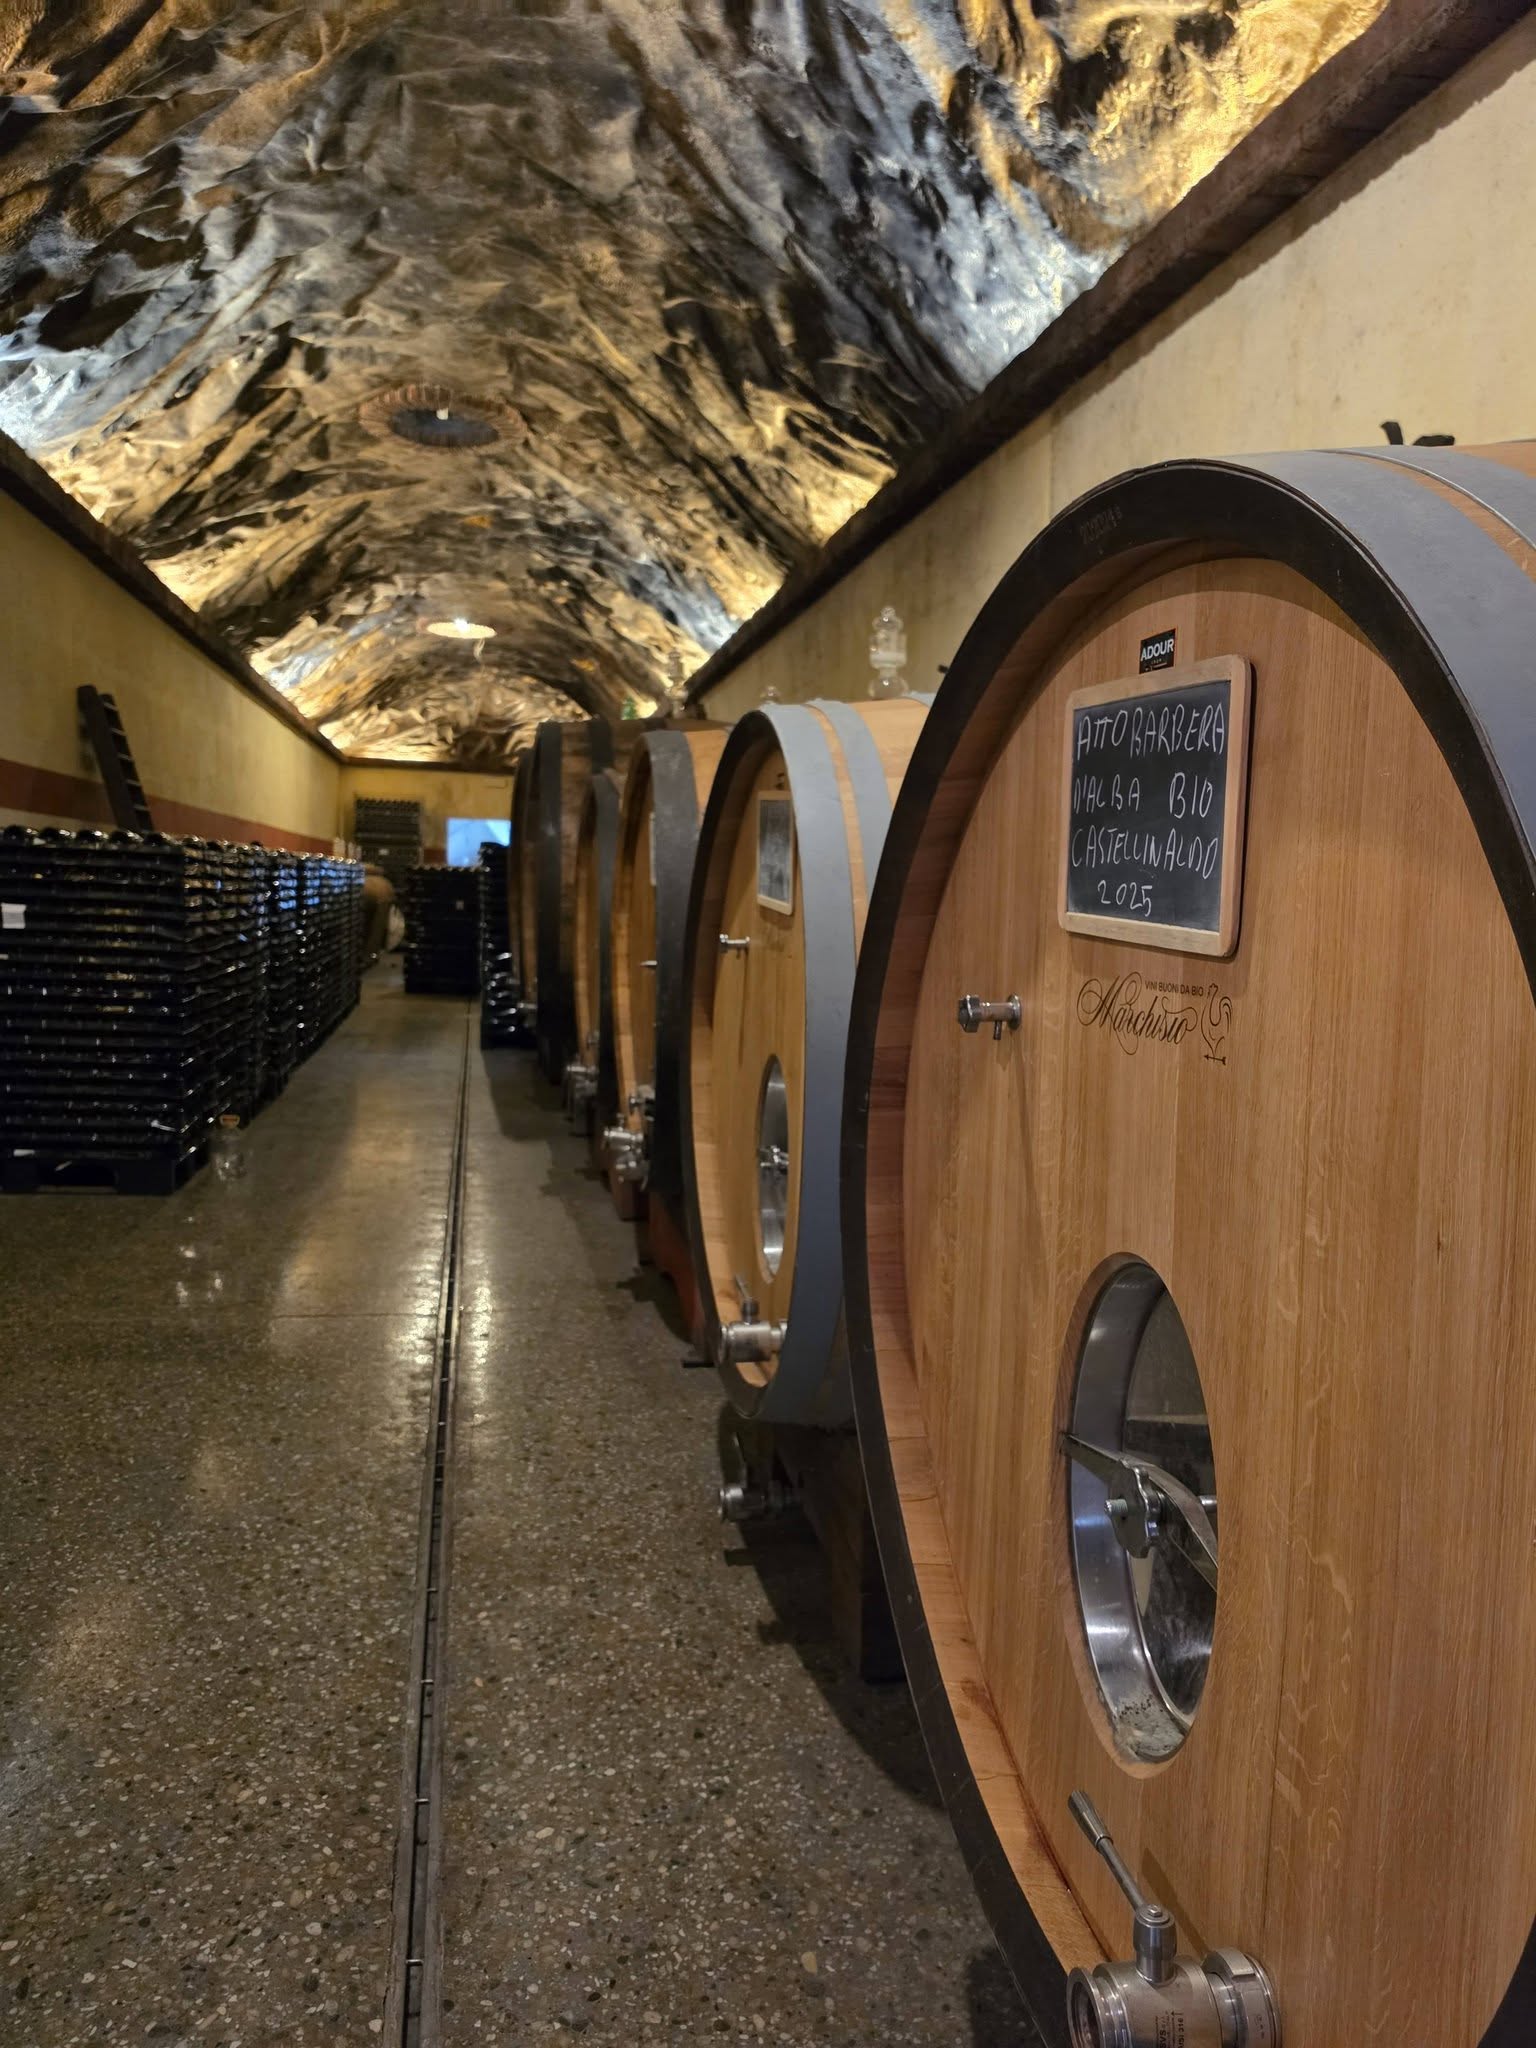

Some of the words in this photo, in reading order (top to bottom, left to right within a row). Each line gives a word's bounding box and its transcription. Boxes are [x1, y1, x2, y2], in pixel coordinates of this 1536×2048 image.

[1140, 638, 1174, 662] ADOUR
[1169, 772, 1213, 818] BIO
[1071, 824, 1219, 879] CASTELLINALDO
[1097, 879, 1153, 917] 2025
[1180, 984, 1190, 995] DA
[1191, 985, 1204, 997] BIO
